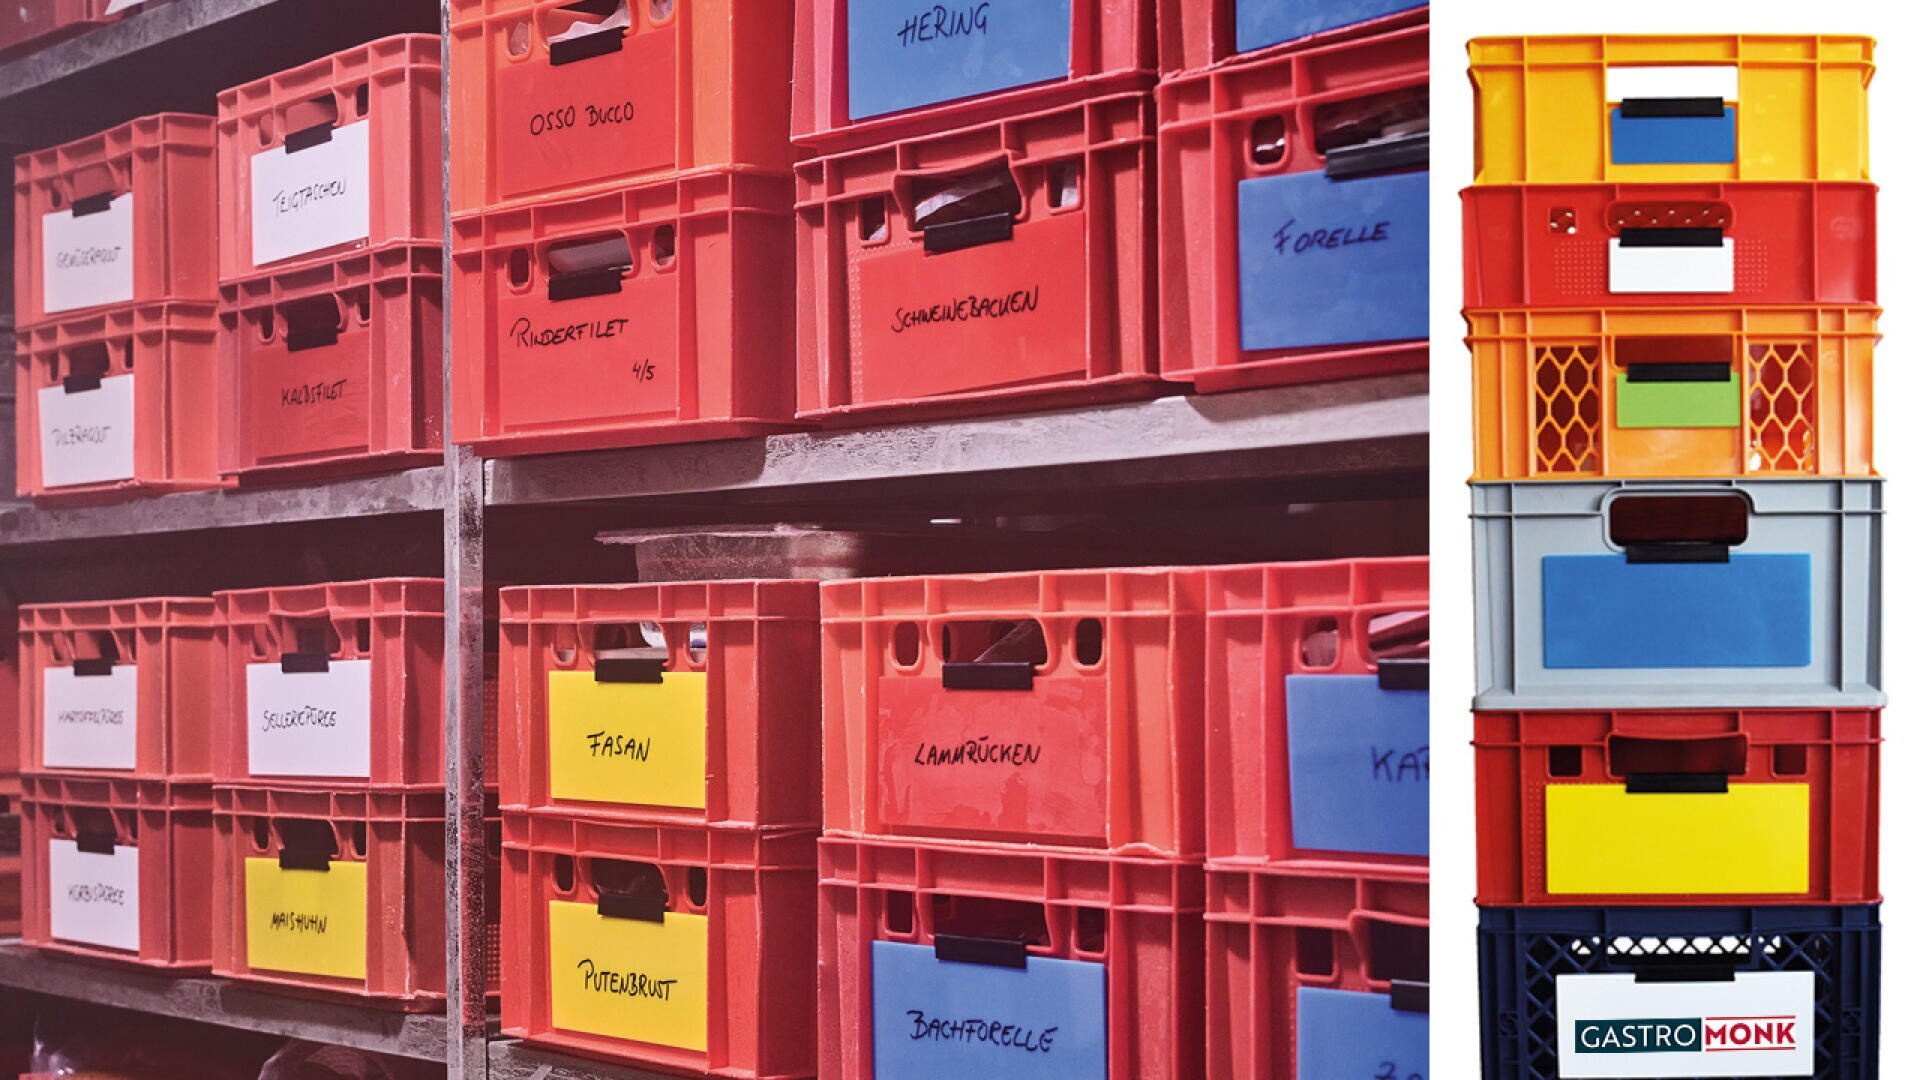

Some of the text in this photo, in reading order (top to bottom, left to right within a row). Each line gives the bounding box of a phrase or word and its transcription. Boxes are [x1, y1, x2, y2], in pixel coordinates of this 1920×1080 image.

[896, 2, 989, 47] HERING
[530, 102, 634, 135] OSSO BUCCO
[1273, 219, 1391, 256] FORELLE
[509, 317, 629, 349] RINDERFILET
[632, 358, 656, 382] 4/5
[281, 379, 346, 407] KALBSFILET
[586, 731, 650, 763] FASAN
[914, 735, 1041, 767] LAMMRÜCKEN
[270, 911, 328, 935] MAISHUHN
[577, 959, 677, 1001] PUTENBRUST
[906, 1010, 1058, 1052] BACHFORELLE
